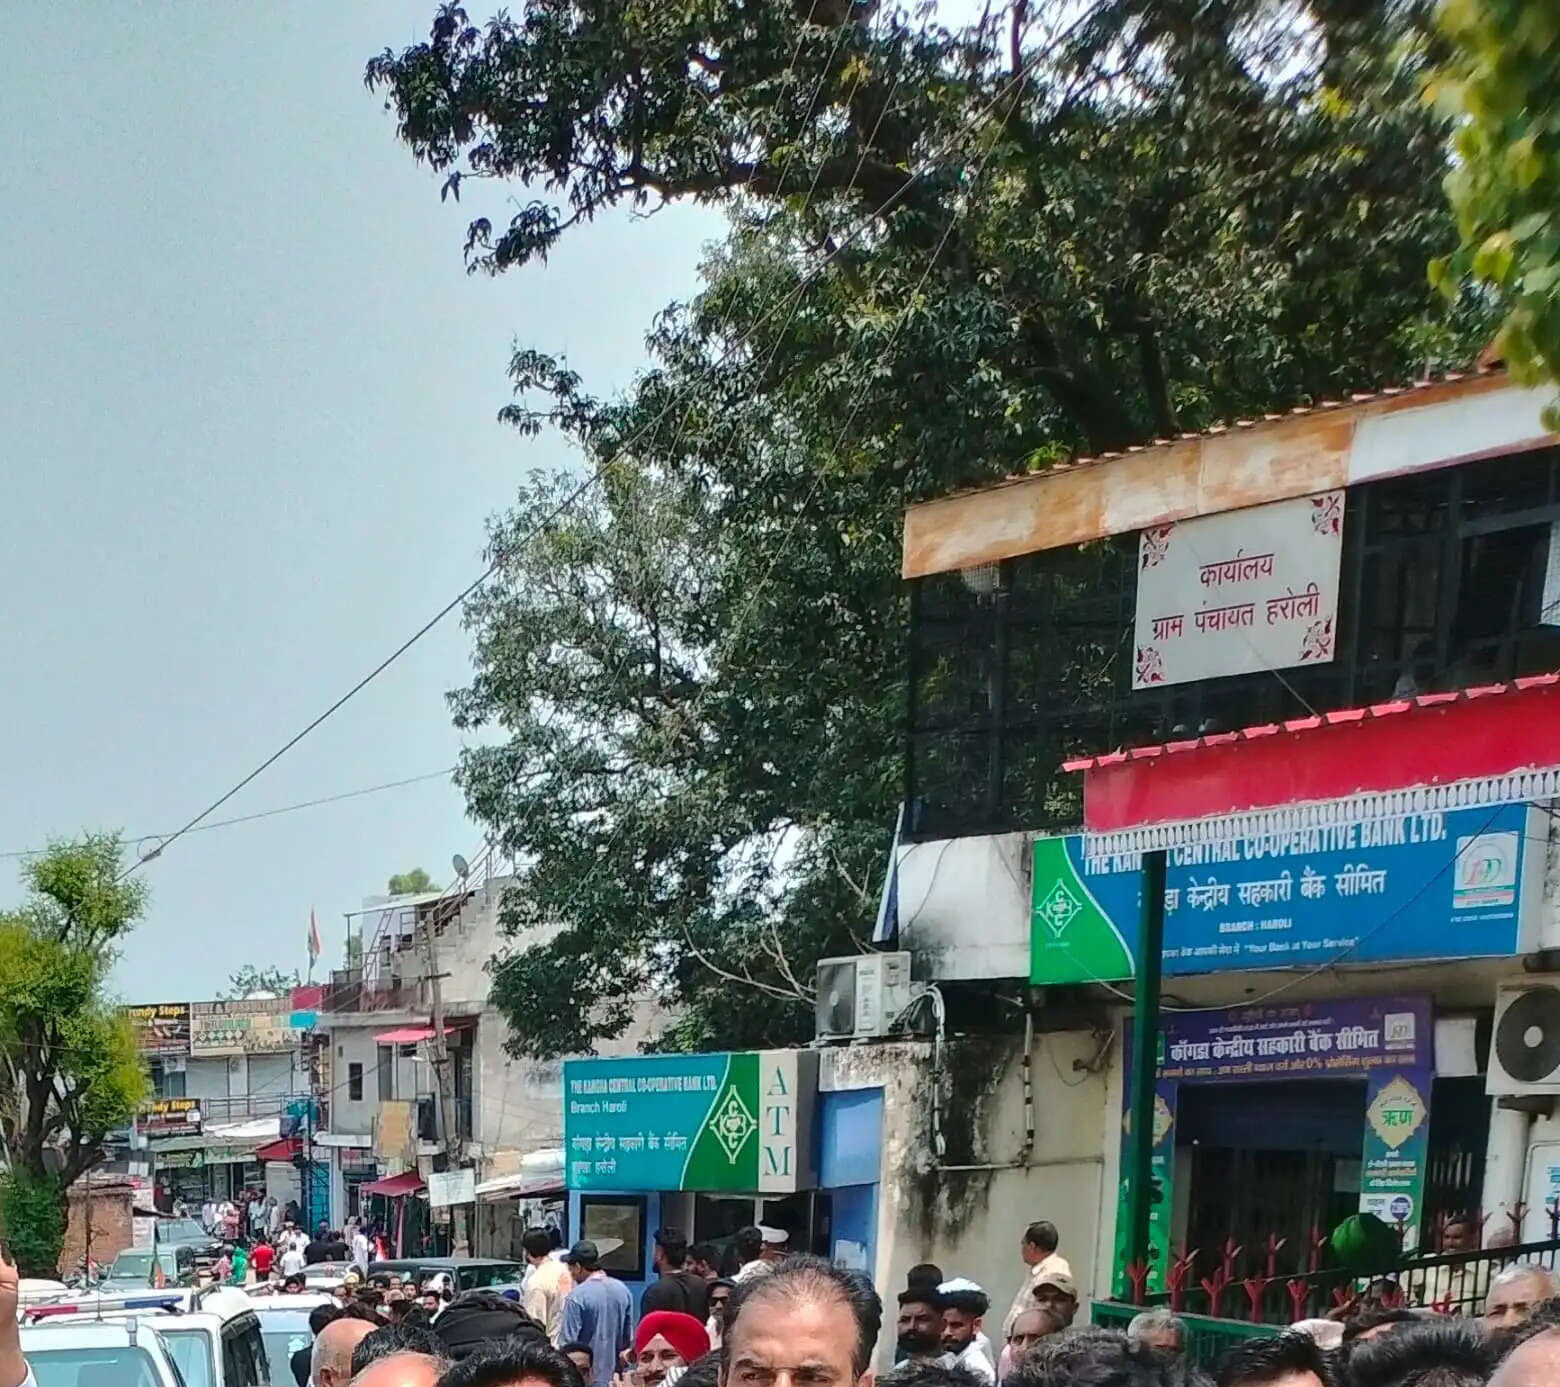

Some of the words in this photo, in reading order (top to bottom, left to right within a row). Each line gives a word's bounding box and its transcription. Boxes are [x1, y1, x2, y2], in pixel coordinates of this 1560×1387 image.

[1200, 549, 1274, 588] कार्यालय
[1152, 614, 1184, 640] ग्राम
[1194, 600, 1255, 633] पंचायत
[1266, 582, 1320, 626] हरोली
[1173, 838, 1240, 867] CENTRAL
[1244, 823, 1357, 861] CO-OPERATIVE
[1360, 816, 1405, 848] BANK
[1411, 812, 1447, 842] LTD.
[1187, 877, 1231, 912] केन्द्रीय
[1237, 870, 1293, 906] सहकारी
[1300, 865, 1326, 899] बैंक
[1335, 863, 1387, 896] सीमित
[159, 1004, 186, 1016] Steps
[1257, 1030, 1306, 1056] सहकारी
[1335, 1026, 1380, 1050] सीमित
[570, 1100, 600, 1113] Branch
[602, 1099, 627, 1112] Haroli
[763, 1065, 792, 1176] ATM
